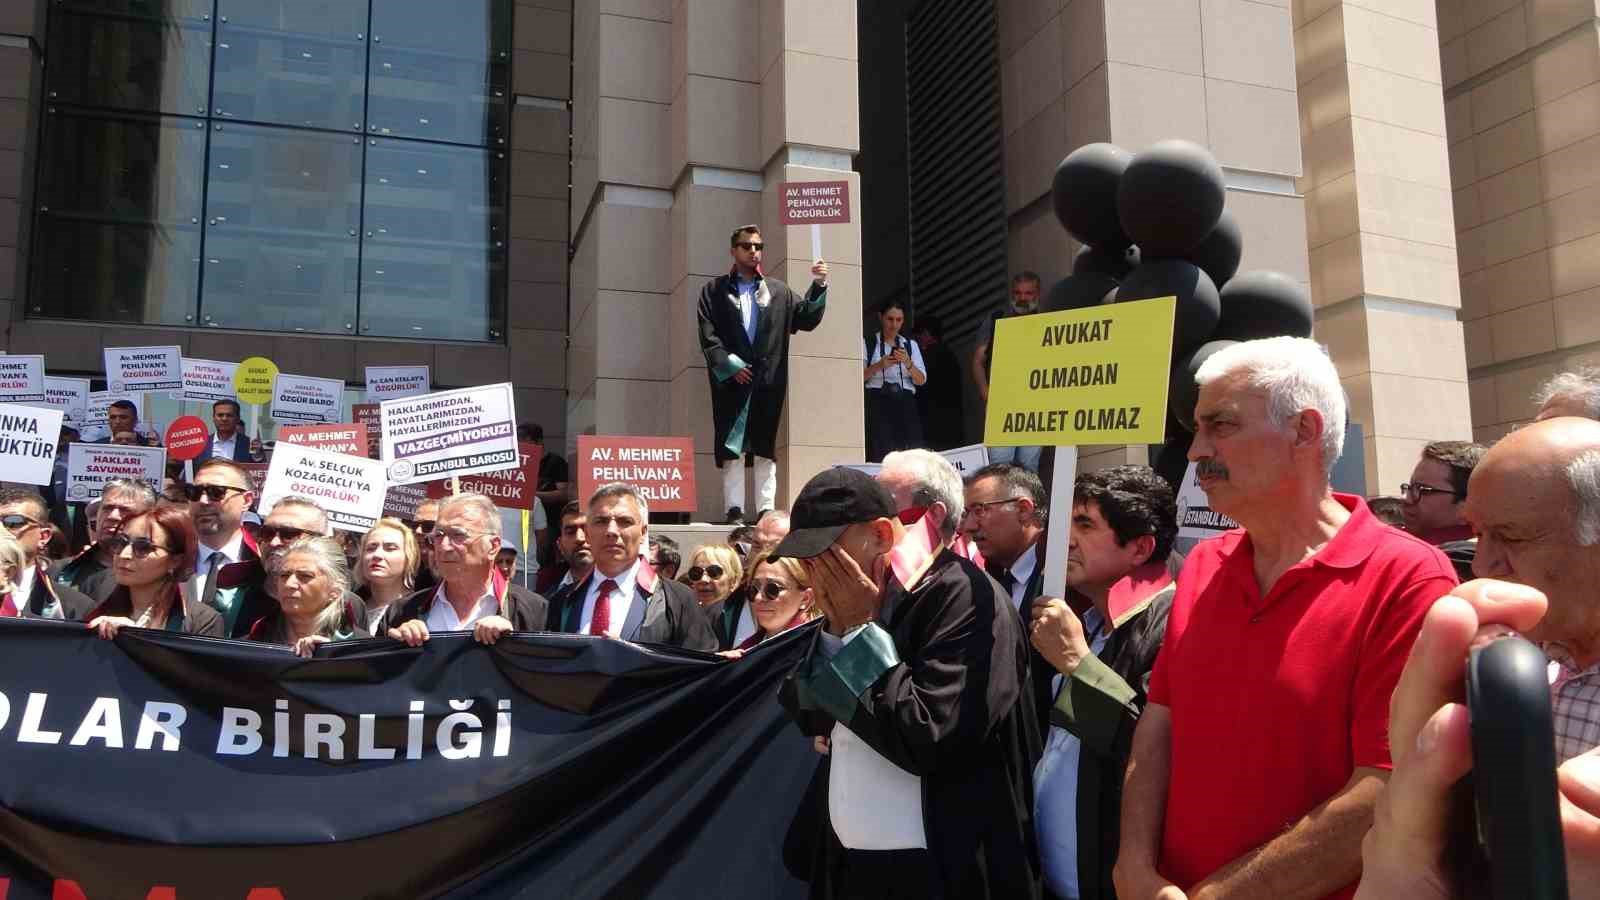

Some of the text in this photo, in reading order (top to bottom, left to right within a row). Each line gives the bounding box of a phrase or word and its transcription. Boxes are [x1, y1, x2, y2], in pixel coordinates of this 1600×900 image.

[786, 187, 842, 196] AV. MEHMET
[787, 198, 842, 208] PEHLİVAN'A
[789, 208, 841, 218] ÖZGÜRLÜK
[1042, 319, 1113, 347] AVUKAT
[1029, 362, 1119, 390] OLMADAN
[0, 414, 38, 434] NMA
[389, 415, 481, 438] HAYALLERİMİZDEN
[1002, 407, 1141, 433] ADALET OLMAZ
[288, 431, 359, 442] AV. MEHMET
[398, 424, 511, 455] VAZGEÇMİYORUZ!
[94, 456, 141, 465] HAKLARI
[417, 458, 470, 475] İSTANBUL
[470, 451, 514, 466] BAROSU
[591, 447, 682, 462] AV. MEHMET
[300, 457, 364, 477] Av. SELÇUK
[592, 465, 682, 480] PEHLİVAN'A
[285, 468, 371, 492] KOZAĞAÇLI'YA
[290, 482, 360, 505] ÖZGÜRLÜK!
[1184, 510, 1219, 526] İSTANBUL
[215, 698, 512, 761] BİRLİĞİ
